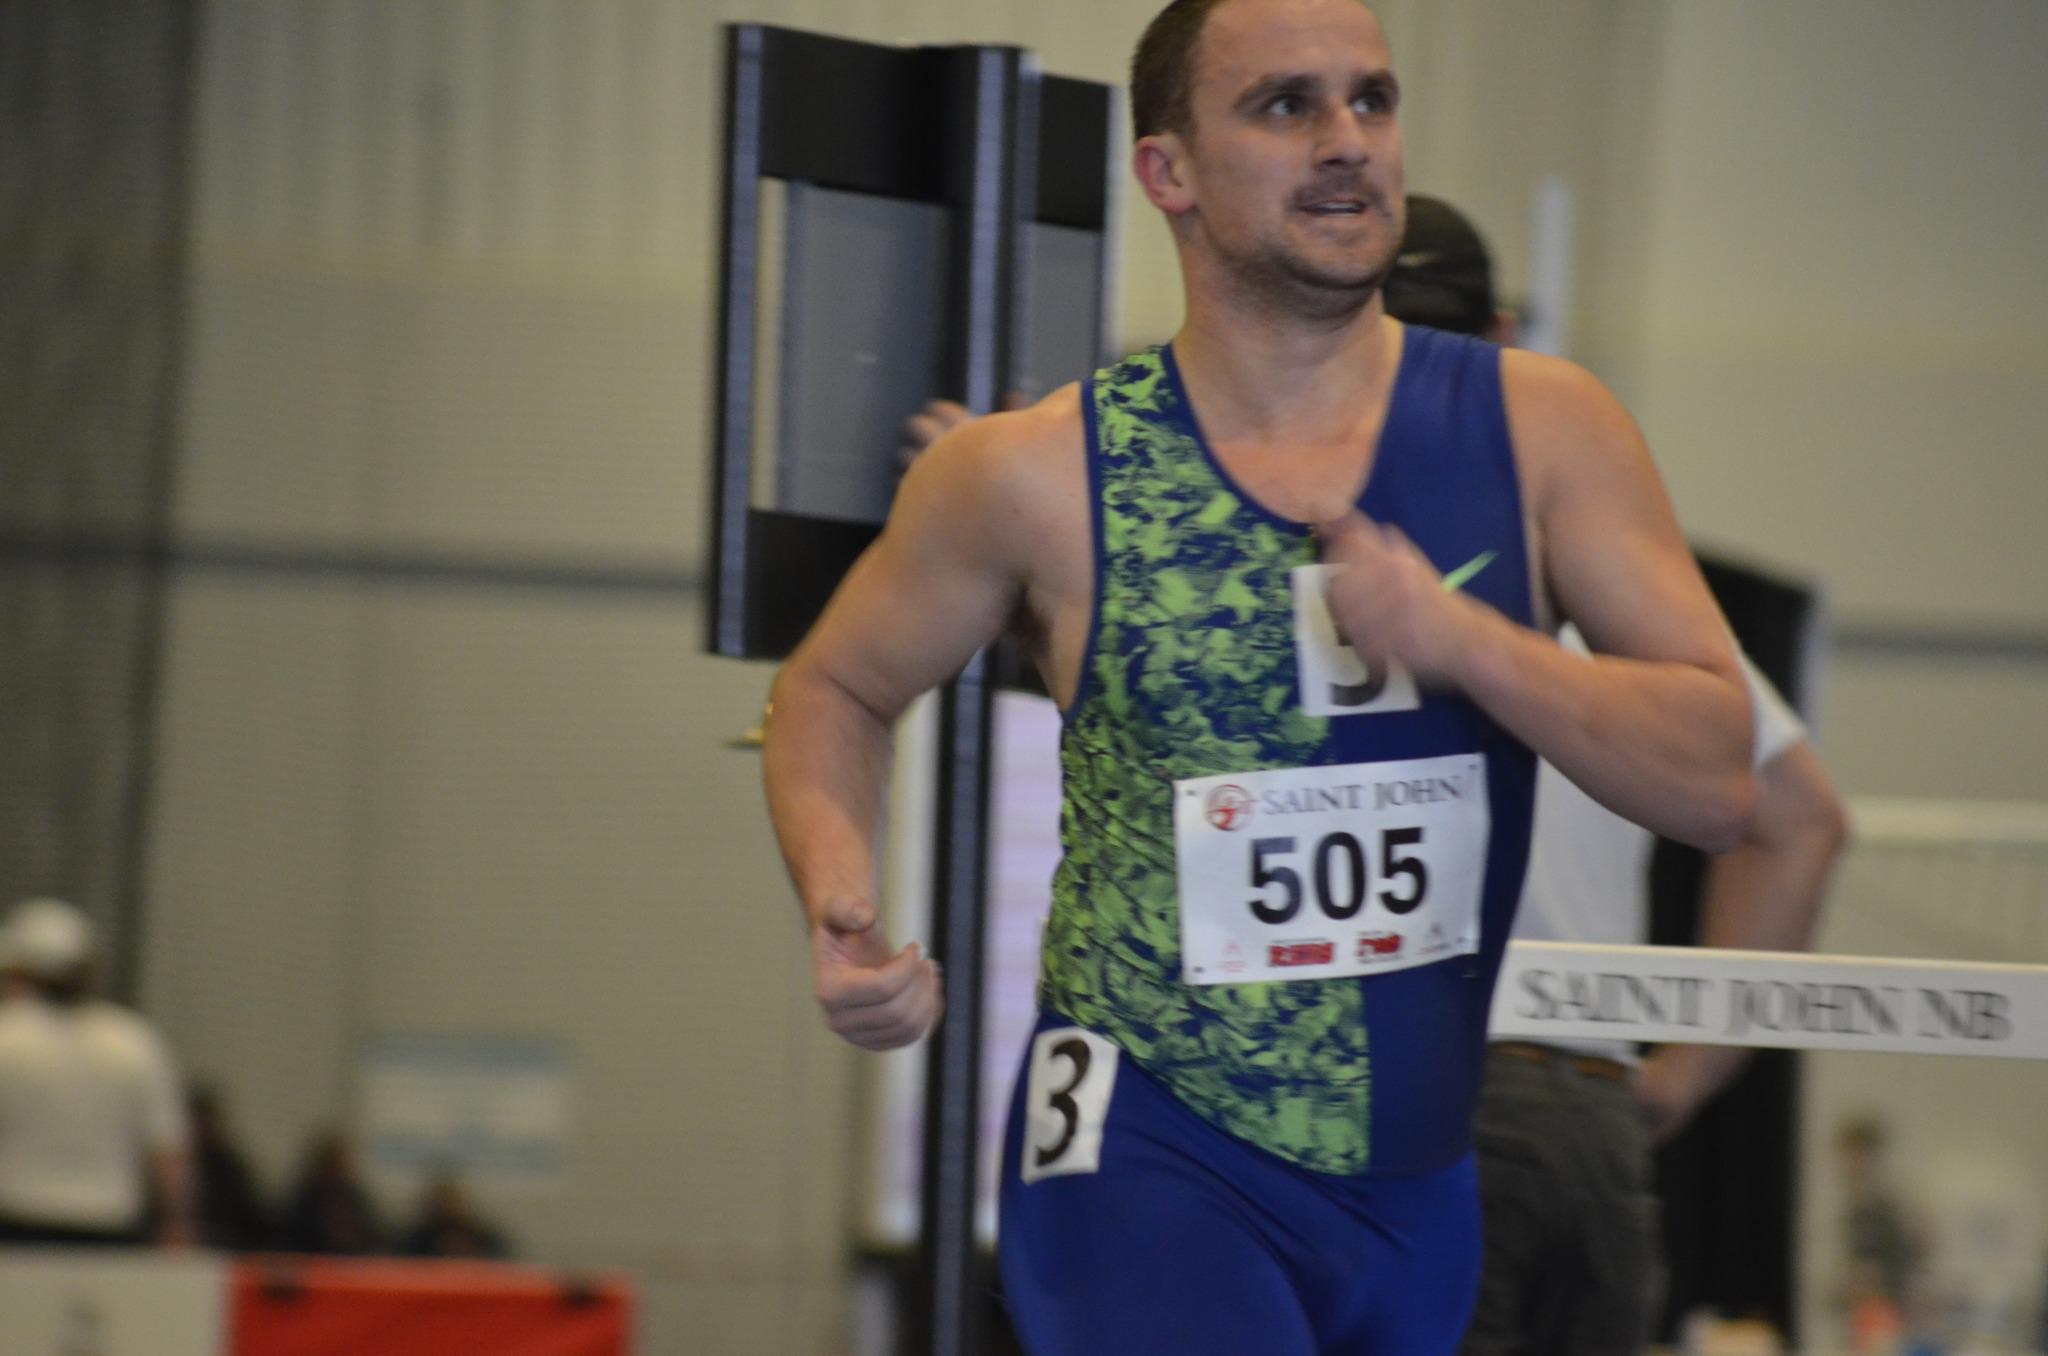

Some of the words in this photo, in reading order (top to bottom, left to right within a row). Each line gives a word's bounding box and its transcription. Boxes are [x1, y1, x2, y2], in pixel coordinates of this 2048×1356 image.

[1262, 784, 1364, 815] SAINT
[1372, 776, 1463, 811] JOHN
[1249, 827, 1427, 925] 505
[1517, 969, 1713, 1027] SAINT
[1722, 978, 1908, 1037] JOHN
[1908, 988, 2014, 1042] NB
[1036, 1038, 1092, 1168] 3
